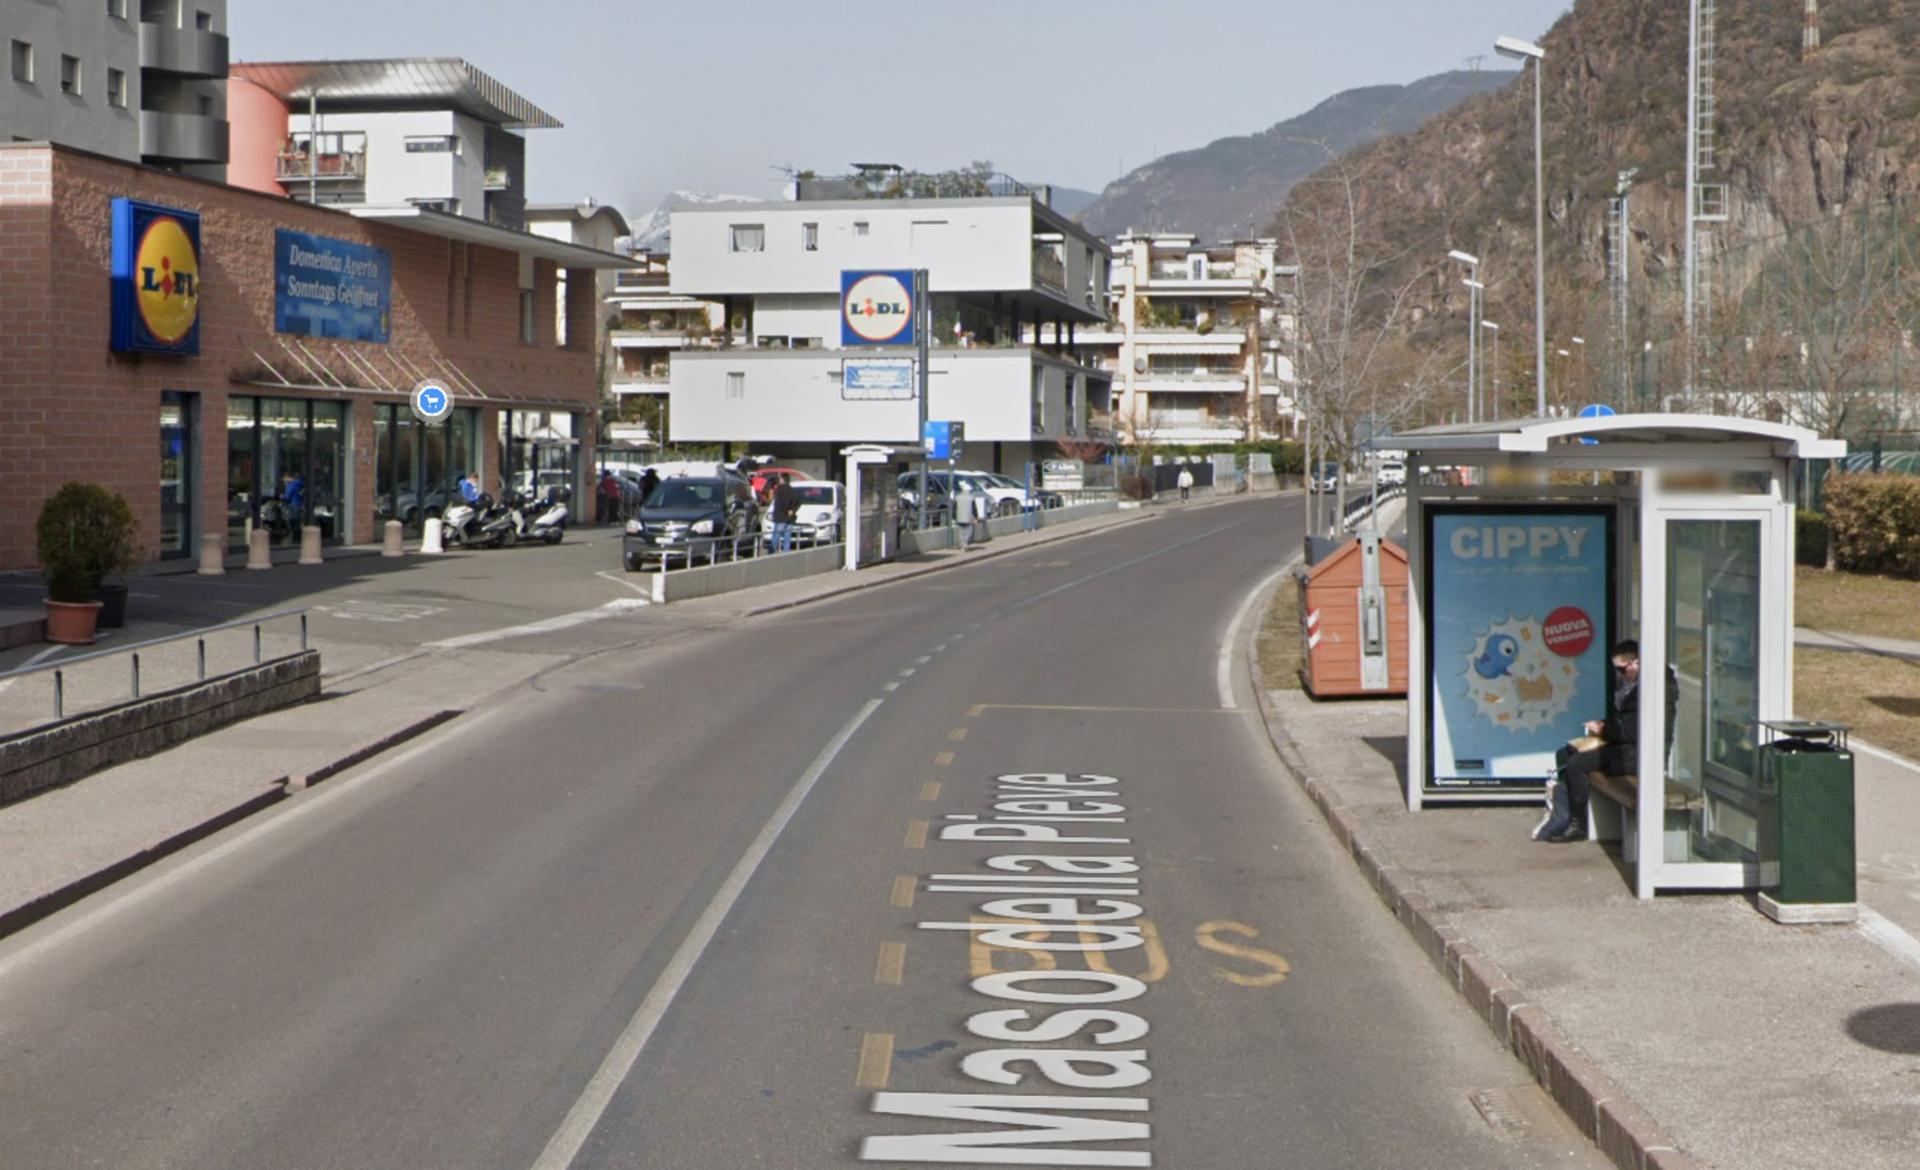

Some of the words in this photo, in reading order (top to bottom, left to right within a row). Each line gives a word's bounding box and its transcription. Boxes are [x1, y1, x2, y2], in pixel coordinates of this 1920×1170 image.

[289, 244, 342, 273] Domenica
[343, 255, 379, 279] Aperto
[287, 275, 337, 305] Sonntags
[337, 283, 379, 310] Geöffnet
[1450, 525, 1589, 560] CIPPY
[1544, 618, 1590, 638] NUOVA
